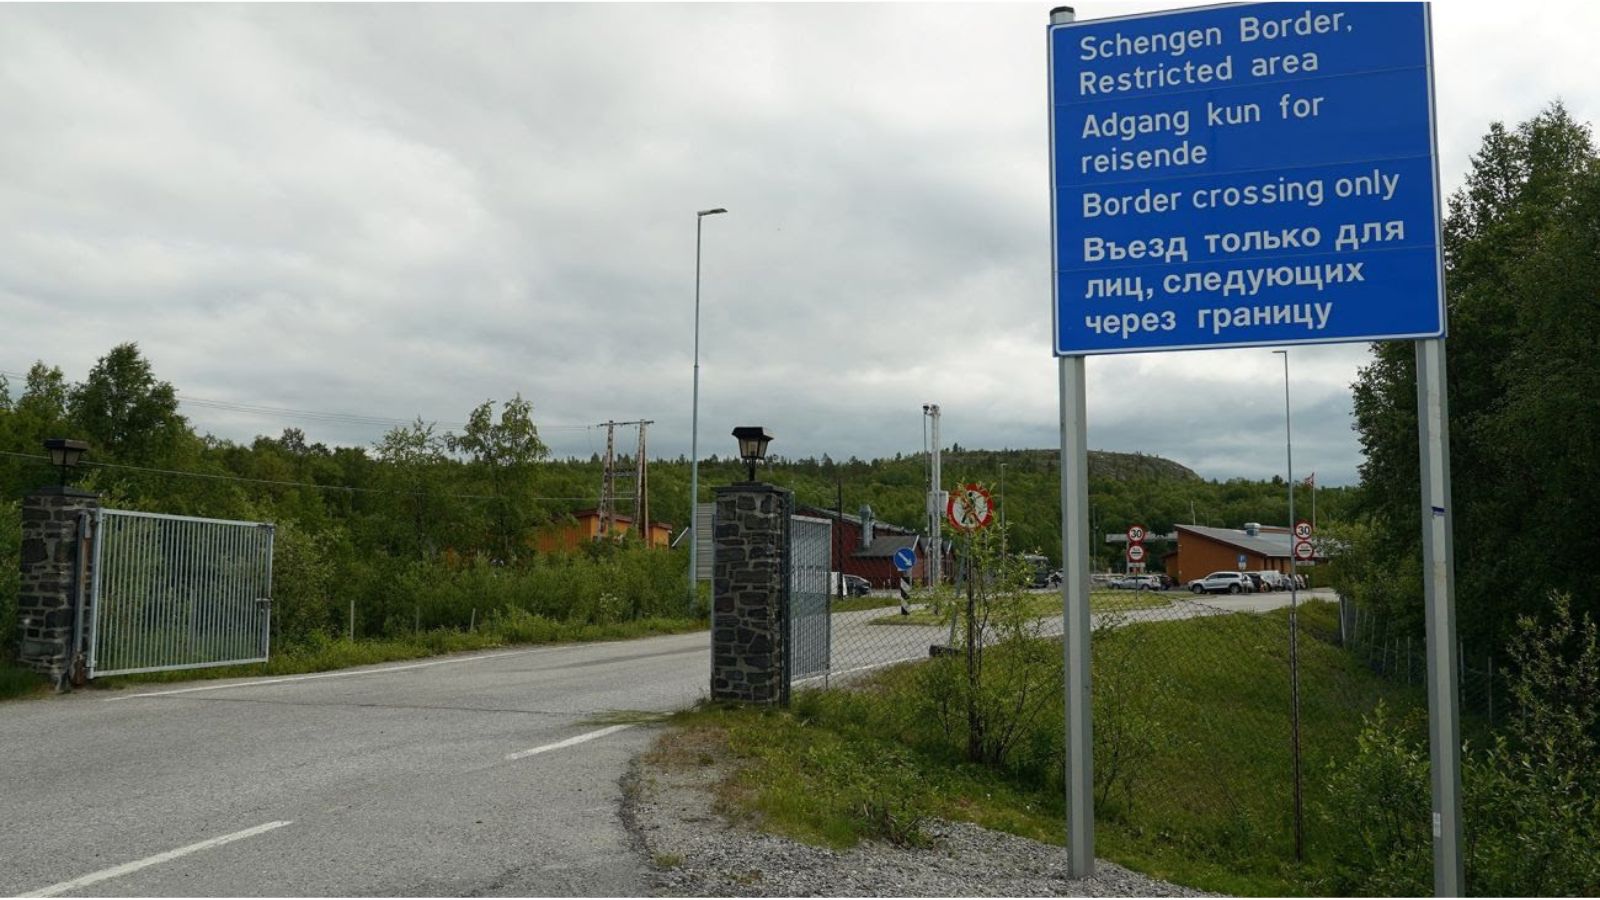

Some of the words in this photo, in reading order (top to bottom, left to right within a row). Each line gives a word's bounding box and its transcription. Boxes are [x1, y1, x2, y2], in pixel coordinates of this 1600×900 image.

[1081, 28, 1221, 60] Schengen
[1241, 11, 1351, 41] Border,
[1081, 55, 1232, 94] Restricted
[1252, 53, 1317, 76] area
[1083, 111, 1189, 140] Adgang
[1208, 103, 1259, 125] kun
[1280, 94, 1323, 118] for
[1083, 141, 1206, 173] reisende
[1084, 189, 1181, 217] Border
[1193, 178, 1323, 207] crossing
[1336, 170, 1398, 199] only
[1085, 238, 1187, 262] Въезд
[1205, 228, 1320, 252] только
[1336, 221, 1403, 250] для
[1086, 278, 1152, 301] лиц,
[1164, 260, 1364, 296] следующих
[1086, 311, 1175, 338] через
[1199, 303, 1331, 333] границу
[1130, 528, 1143, 538] 30
[1297, 525, 1311, 536] 30
